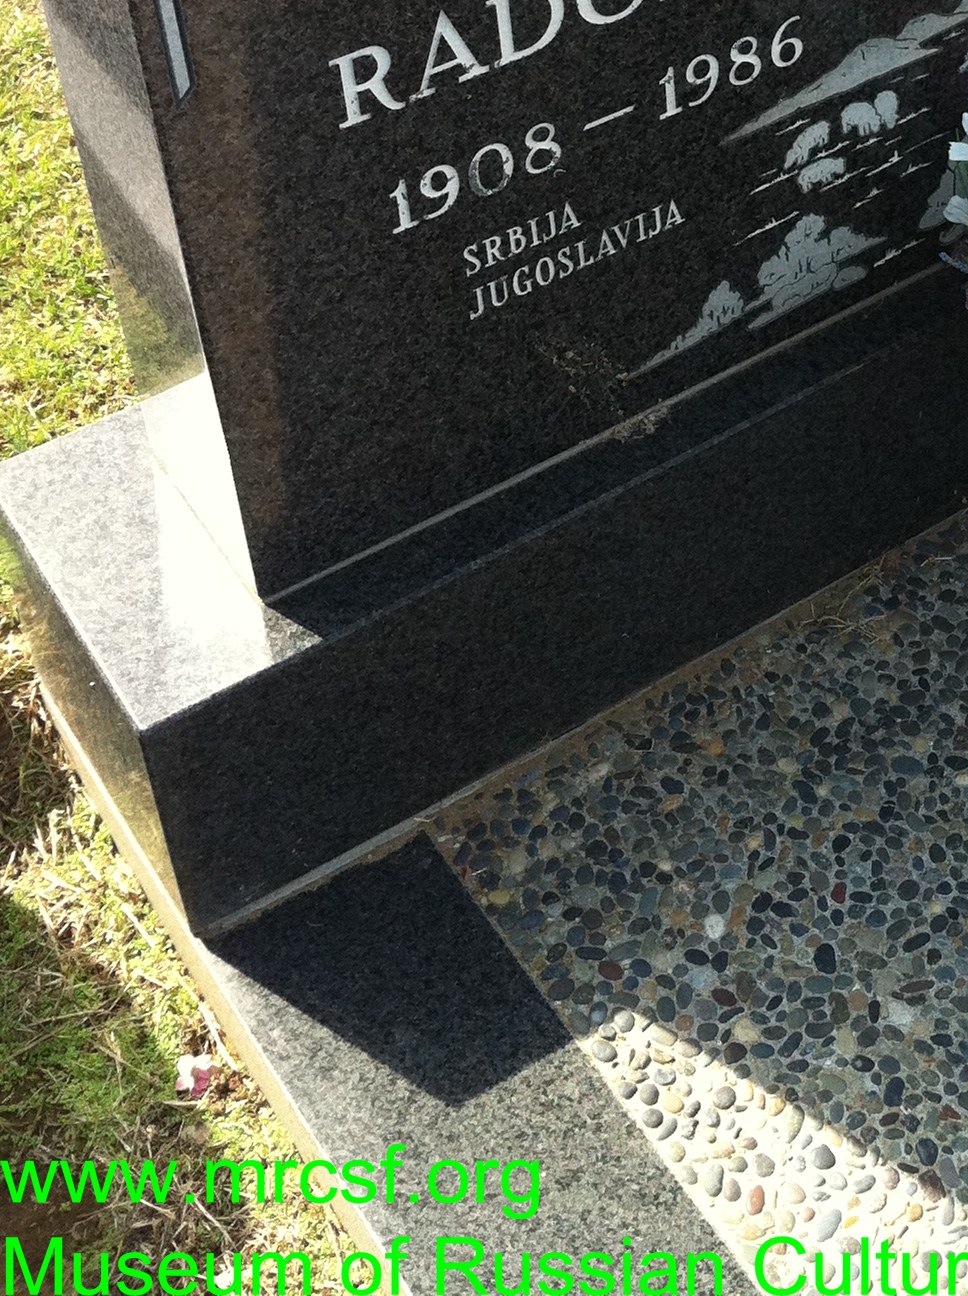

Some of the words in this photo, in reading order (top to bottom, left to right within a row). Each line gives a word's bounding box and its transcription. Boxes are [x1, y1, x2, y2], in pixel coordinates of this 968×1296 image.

[388, 122, 563, 234] 1908
[658, 15, 804, 120] 1986
[464, 201, 583, 278] SRBIJA
[469, 199, 686, 321] JUGOSLAVIJA
